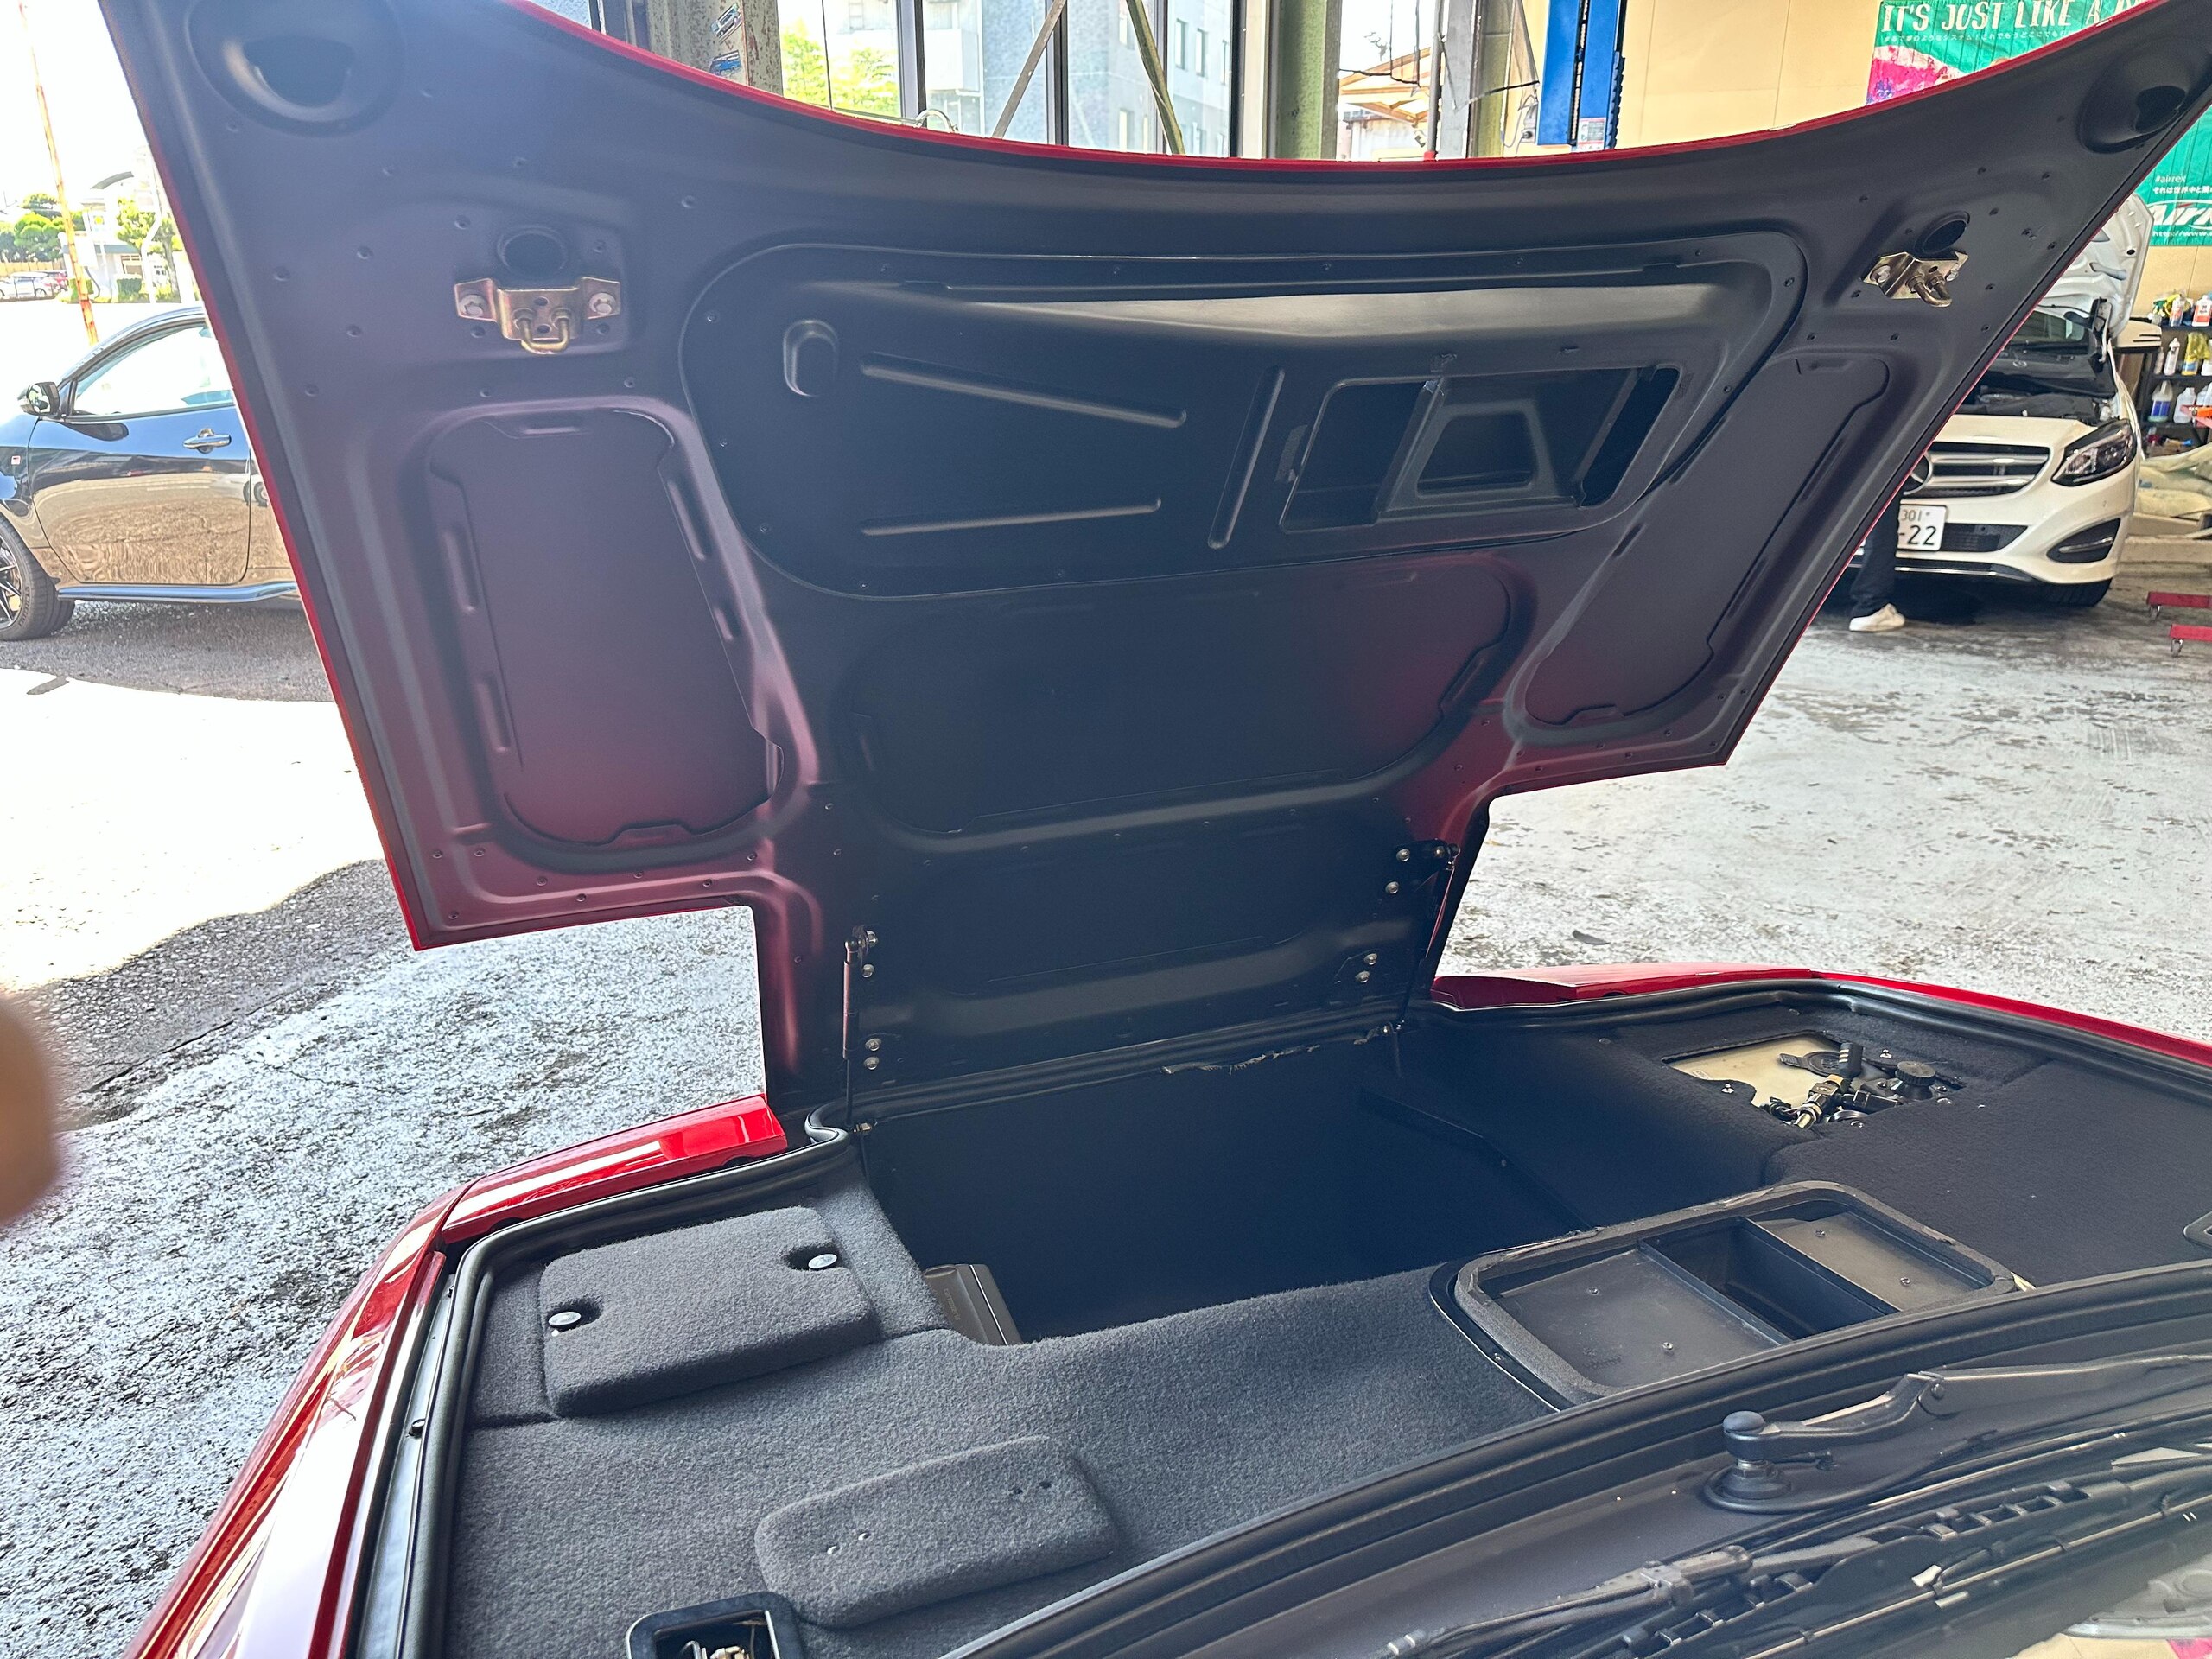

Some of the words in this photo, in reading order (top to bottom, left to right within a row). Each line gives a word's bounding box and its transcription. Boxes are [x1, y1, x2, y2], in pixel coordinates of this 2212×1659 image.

[1881, 3, 1931, 32] IT'S
[1941, 1, 2006, 30] JUST
[2014, 0, 2074, 29] LIKE
[2085, 0, 2103, 25] A
[1901, 509, 1923, 522] 301
